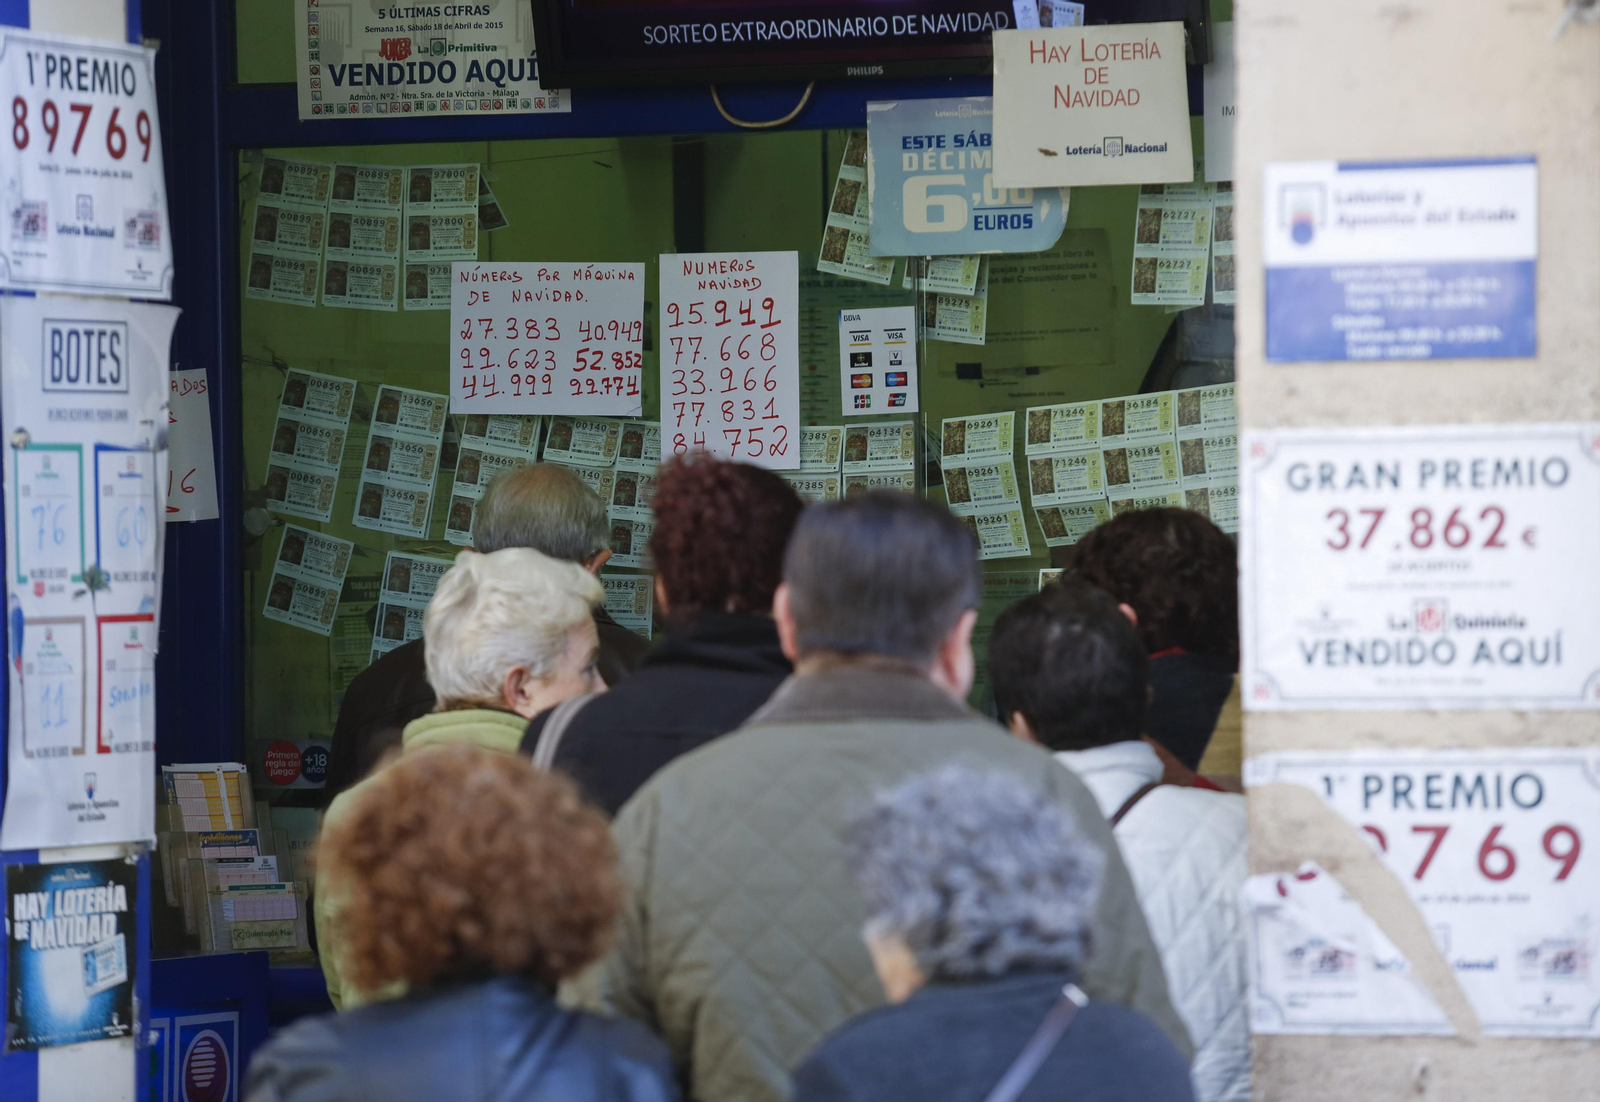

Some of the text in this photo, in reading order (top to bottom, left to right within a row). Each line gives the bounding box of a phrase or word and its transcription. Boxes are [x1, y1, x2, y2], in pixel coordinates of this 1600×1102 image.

[378, 5, 490, 20] 5 ÚLTIMAS CIFRAS
[396, 25, 406, 33] 16,
[408, 24, 432, 32] Sábado
[454, 22, 472, 30] Abril
[644, 24, 716, 44] SORTEO
[722, 17, 888, 42] EXTRAORDINARIO
[893, 15, 918, 34] DE
[921, 12, 1008, 32] NAVIDAD
[378, 38, 412, 61] JOKER
[418, 43, 497, 54] La Primitiva
[1030, 38, 1161, 64] HAY LOTERÍA
[328, 50, 539, 87] VENDIDO AQUÍ
[847, 66, 884, 76] PHILIPS
[46, 54, 136, 96] PREMIO
[1084, 67, 1109, 84] DE
[350, 93, 377, 101] Admón.
[402, 91, 418, 99] Ntra.
[493, 90, 519, 98] Málaga
[1054, 85, 1140, 108] NAVIDAD
[12, 95, 152, 162] 89769
[902, 130, 992, 149] ESTE SÁB
[1067, 142, 1167, 155] Lotería Nacional
[903, 148, 992, 172] DÉCIM
[287, 164, 319, 176] 60899
[358, 169, 390, 179] 40899
[433, 170, 465, 179] 97800
[280, 212, 311, 223] 60899
[1163, 211, 1196, 219] 62727
[353, 217, 385, 227] 40899
[432, 217, 463, 226] 97800
[974, 213, 1033, 231] EUROS
[274, 259, 306, 271] 60899
[350, 266, 382, 275] 40899
[683, 260, 755, 276] NUMEROS
[468, 291, 490, 306] DE
[938, 297, 970, 307] 89275
[667, 298, 781, 329] 95.949
[461, 318, 642, 342] 27.383 40.949
[853, 332, 903, 342] VISA VISA
[670, 332, 776, 365] 77.668
[51, 328, 121, 384] BOTES
[573, 348, 642, 372] 52.852
[310, 379, 340, 391] 00856
[462, 374, 552, 399] 44.999
[672, 365, 777, 396] 33.966
[402, 395, 432, 407] 13656
[1126, 398, 1159, 409] 36184
[673, 397, 779, 427] 77.831
[1053, 408, 1085, 417] 71246
[575, 421, 607, 432] 00140
[967, 419, 998, 429] 69261
[300, 425, 331, 438] 00856
[869, 428, 901, 437] 64134
[394, 441, 423, 453] 13656
[673, 425, 788, 457] 84.752
[1128, 447, 1160, 457] 36184
[482, 455, 514, 466] 49469
[1054, 457, 1087, 467] 71246
[574, 469, 600, 479] 0140
[968, 466, 999, 477] 69261
[1286, 456, 1570, 492] GRAN PREMIO
[290, 472, 321, 485] 00856
[869, 477, 902, 486] 64134
[385, 489, 415, 501] 13656
[1135, 498, 1167, 507] 59328
[977, 514, 1008, 525] 69261
[1325, 505, 1538, 551] 37.862 €
[307, 537, 339, 552] 50899
[413, 563, 444, 573] 25338
[296, 584, 326, 598] 50899
[604, 581, 635, 589] 21842
[1298, 628, 1563, 668] VENDIDO AQUÍ
[268, 751, 298, 759] Primera
[305, 754, 327, 766] +18
[266, 760, 285, 768] regla
[306, 766, 325, 774] años
[270, 767, 296, 776] juego:
[1362, 772, 1544, 810] PREMIO
[14, 881, 128, 921] HAY LOTERÍA
[14, 914, 117, 950] DE NAVIDAD
